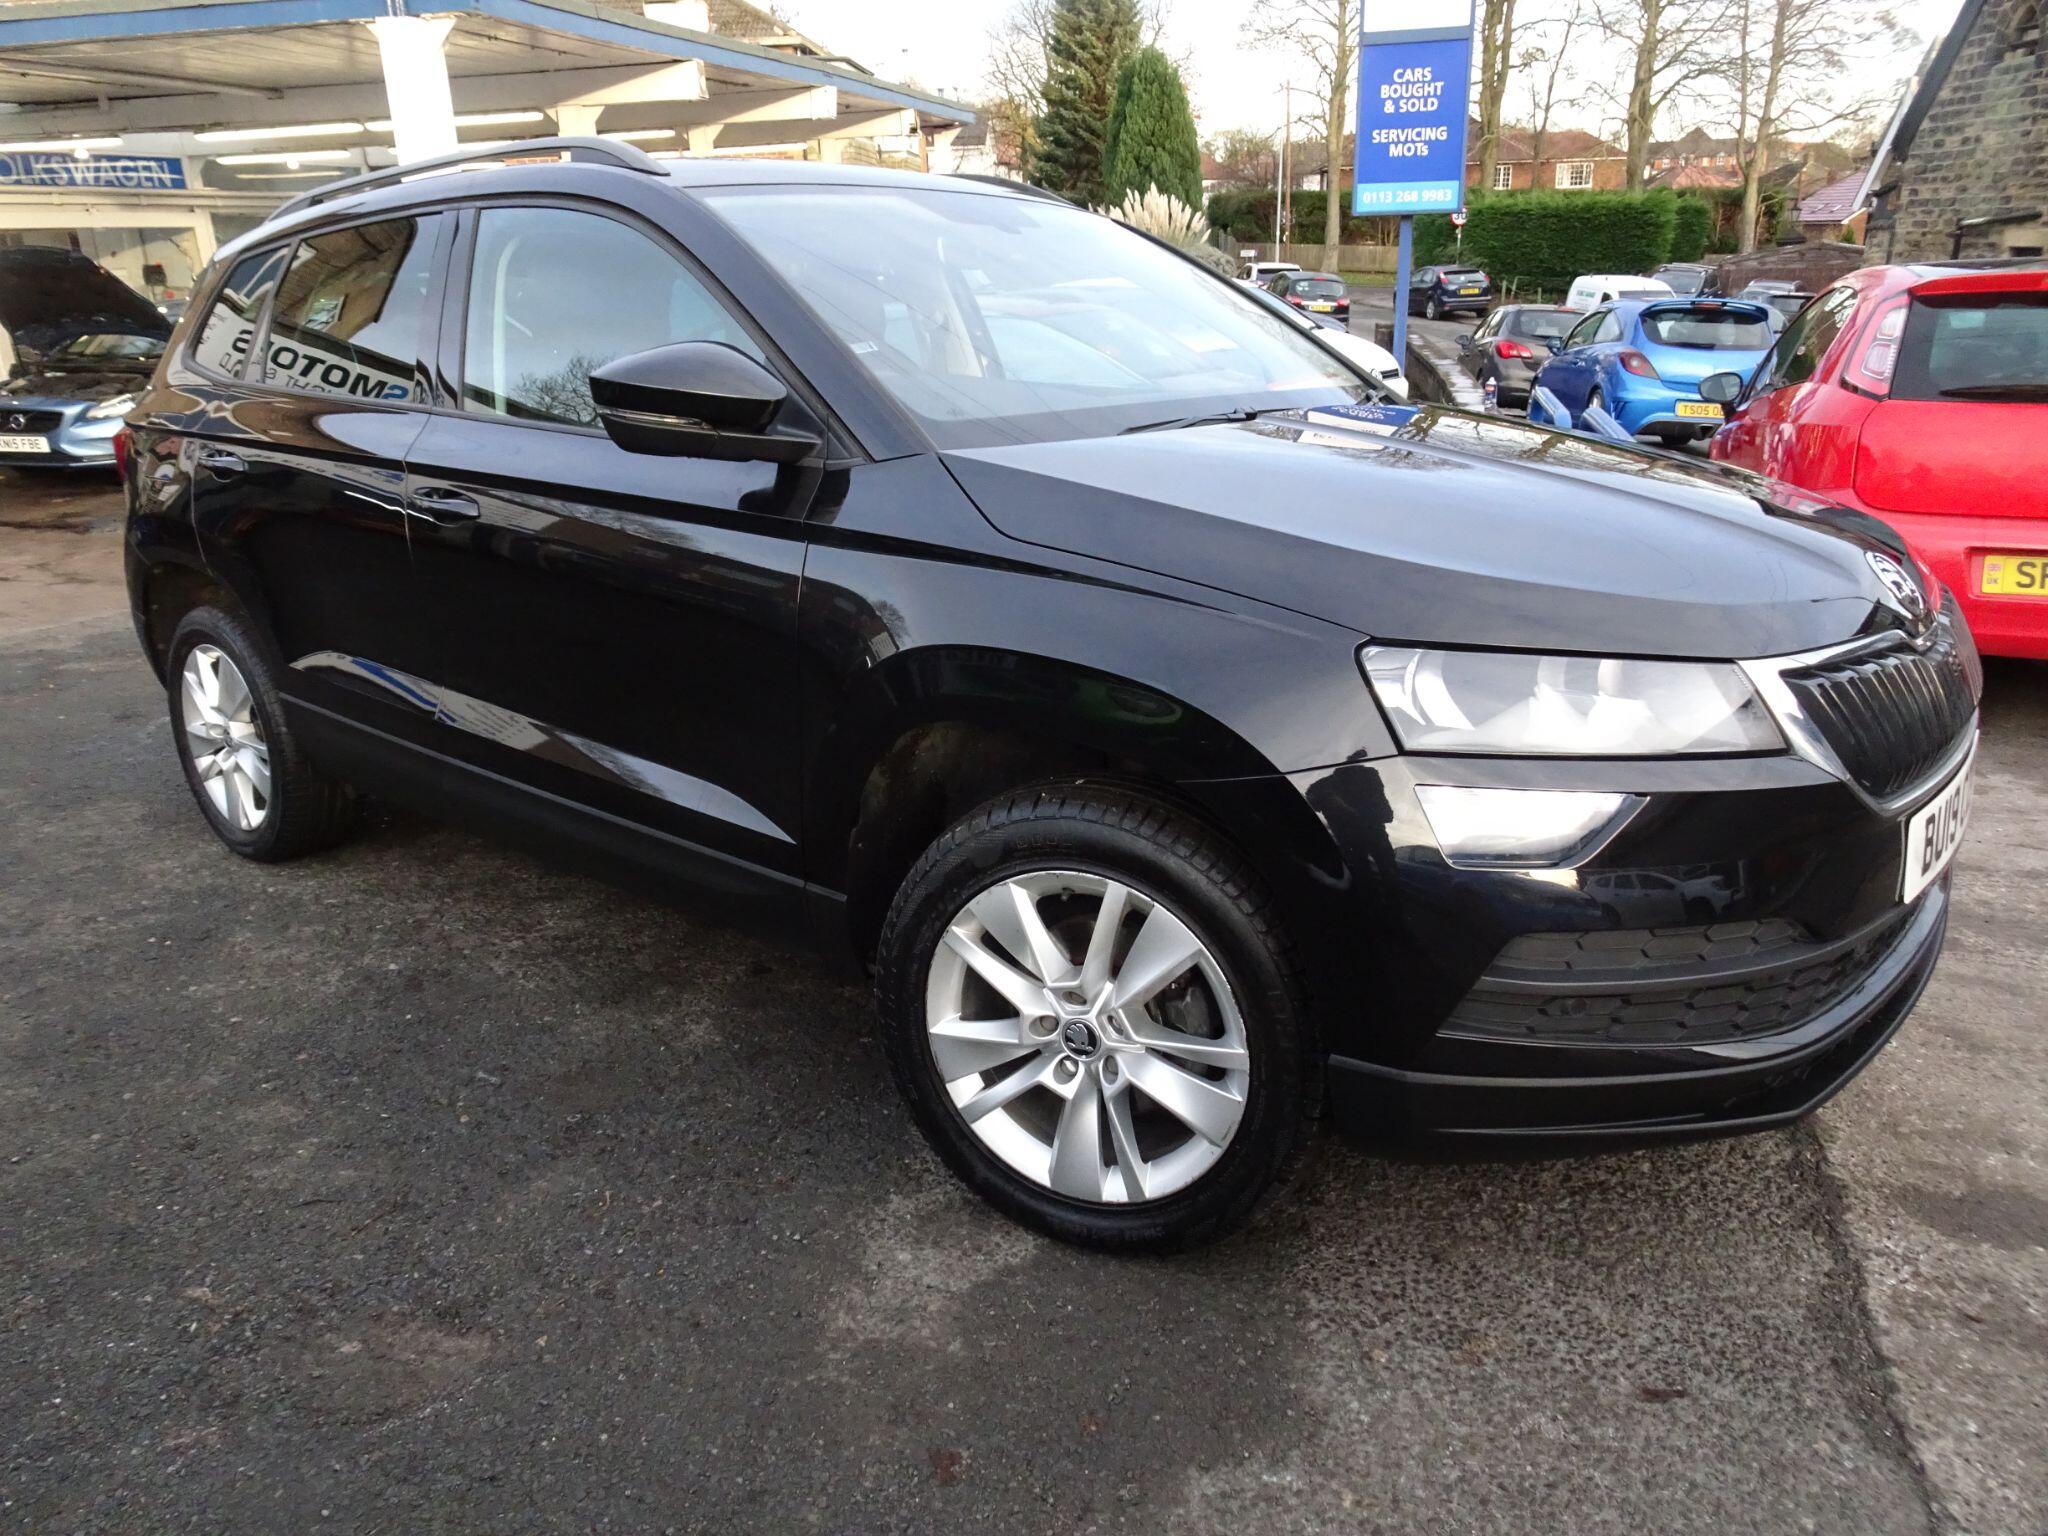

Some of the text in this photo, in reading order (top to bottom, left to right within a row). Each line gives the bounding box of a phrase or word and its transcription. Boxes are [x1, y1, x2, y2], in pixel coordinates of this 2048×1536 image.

[1393, 67, 1432, 82] CARS
[1380, 82, 1444, 99] BOUGHT
[1384, 98, 1439, 113] & SOLD
[1372, 126, 1447, 143] SERVICING
[1389, 143, 1429, 158] MOTs
[1362, 190, 1392, 204] 0113
